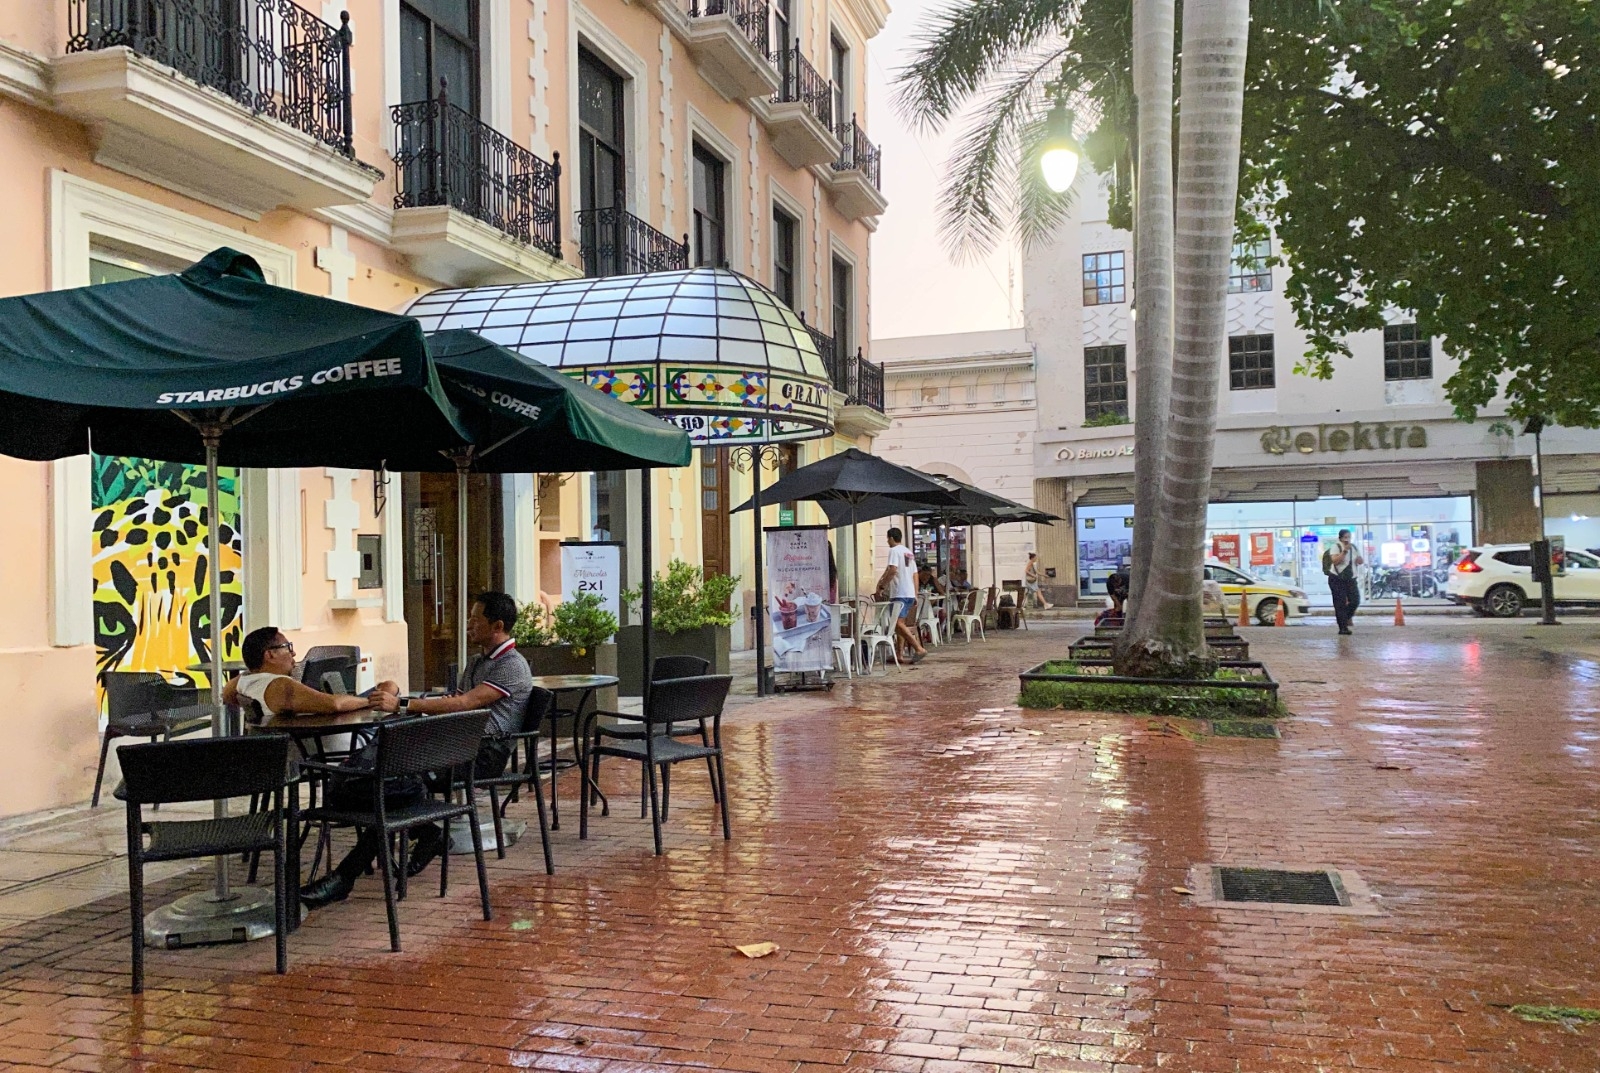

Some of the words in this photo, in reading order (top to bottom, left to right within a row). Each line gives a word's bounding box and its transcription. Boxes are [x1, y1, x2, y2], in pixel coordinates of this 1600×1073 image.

[156, 376, 304, 404] STARBUCKS
[311, 357, 402, 385] COFFEE
[490, 391, 541, 420] COFFEE
[782, 383, 823, 405] GRAN
[1078, 448, 1116, 459] Banco
